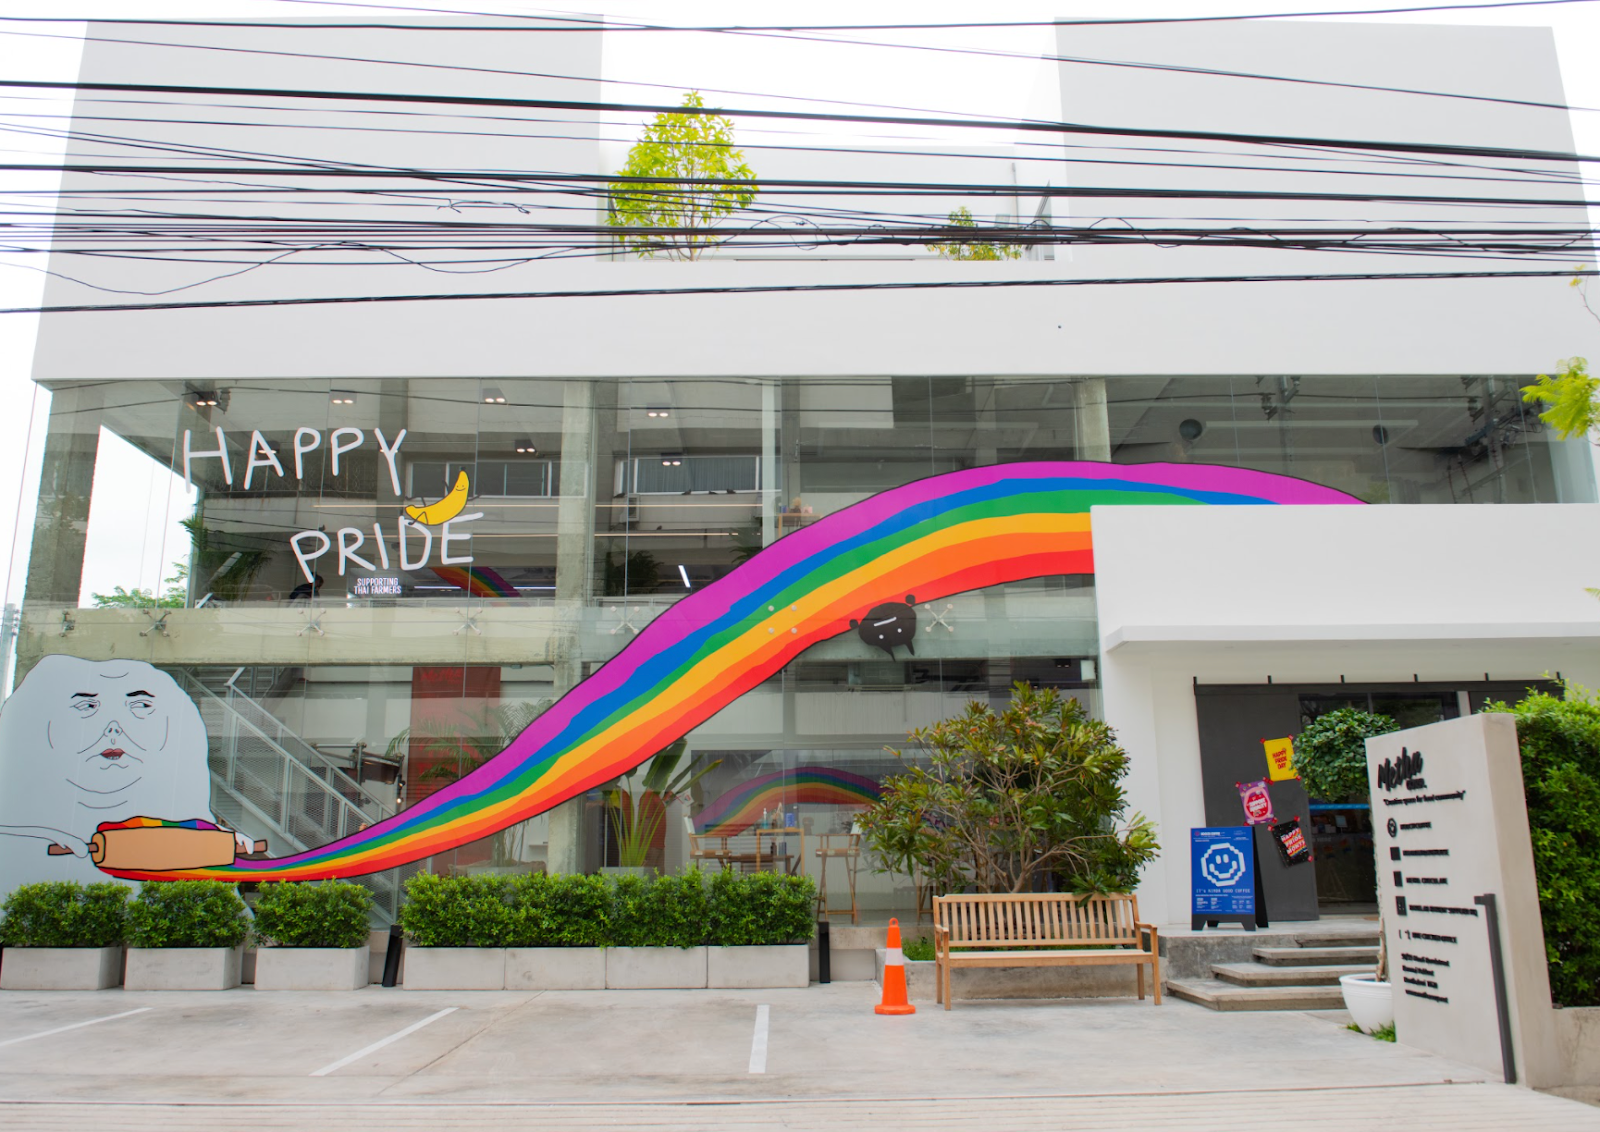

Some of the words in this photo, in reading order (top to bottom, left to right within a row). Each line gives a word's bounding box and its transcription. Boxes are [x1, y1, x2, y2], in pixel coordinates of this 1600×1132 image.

[183, 426, 407, 496] HAPPY
[290, 512, 484, 583] PRIDE
[357, 577, 399, 586] SUPPORTING
[354, 585, 370, 595] THAI
[371, 585, 402, 595] FARMERS
[1272, 749, 1287, 759] HAPPY
[1275, 756, 1288, 764] PRIDE
[1277, 762, 1287, 770] DAY
[1378, 746, 1423, 792] Metha
[1280, 827, 1300, 842] HAPPY
[1284, 834, 1303, 848] PRIDE
